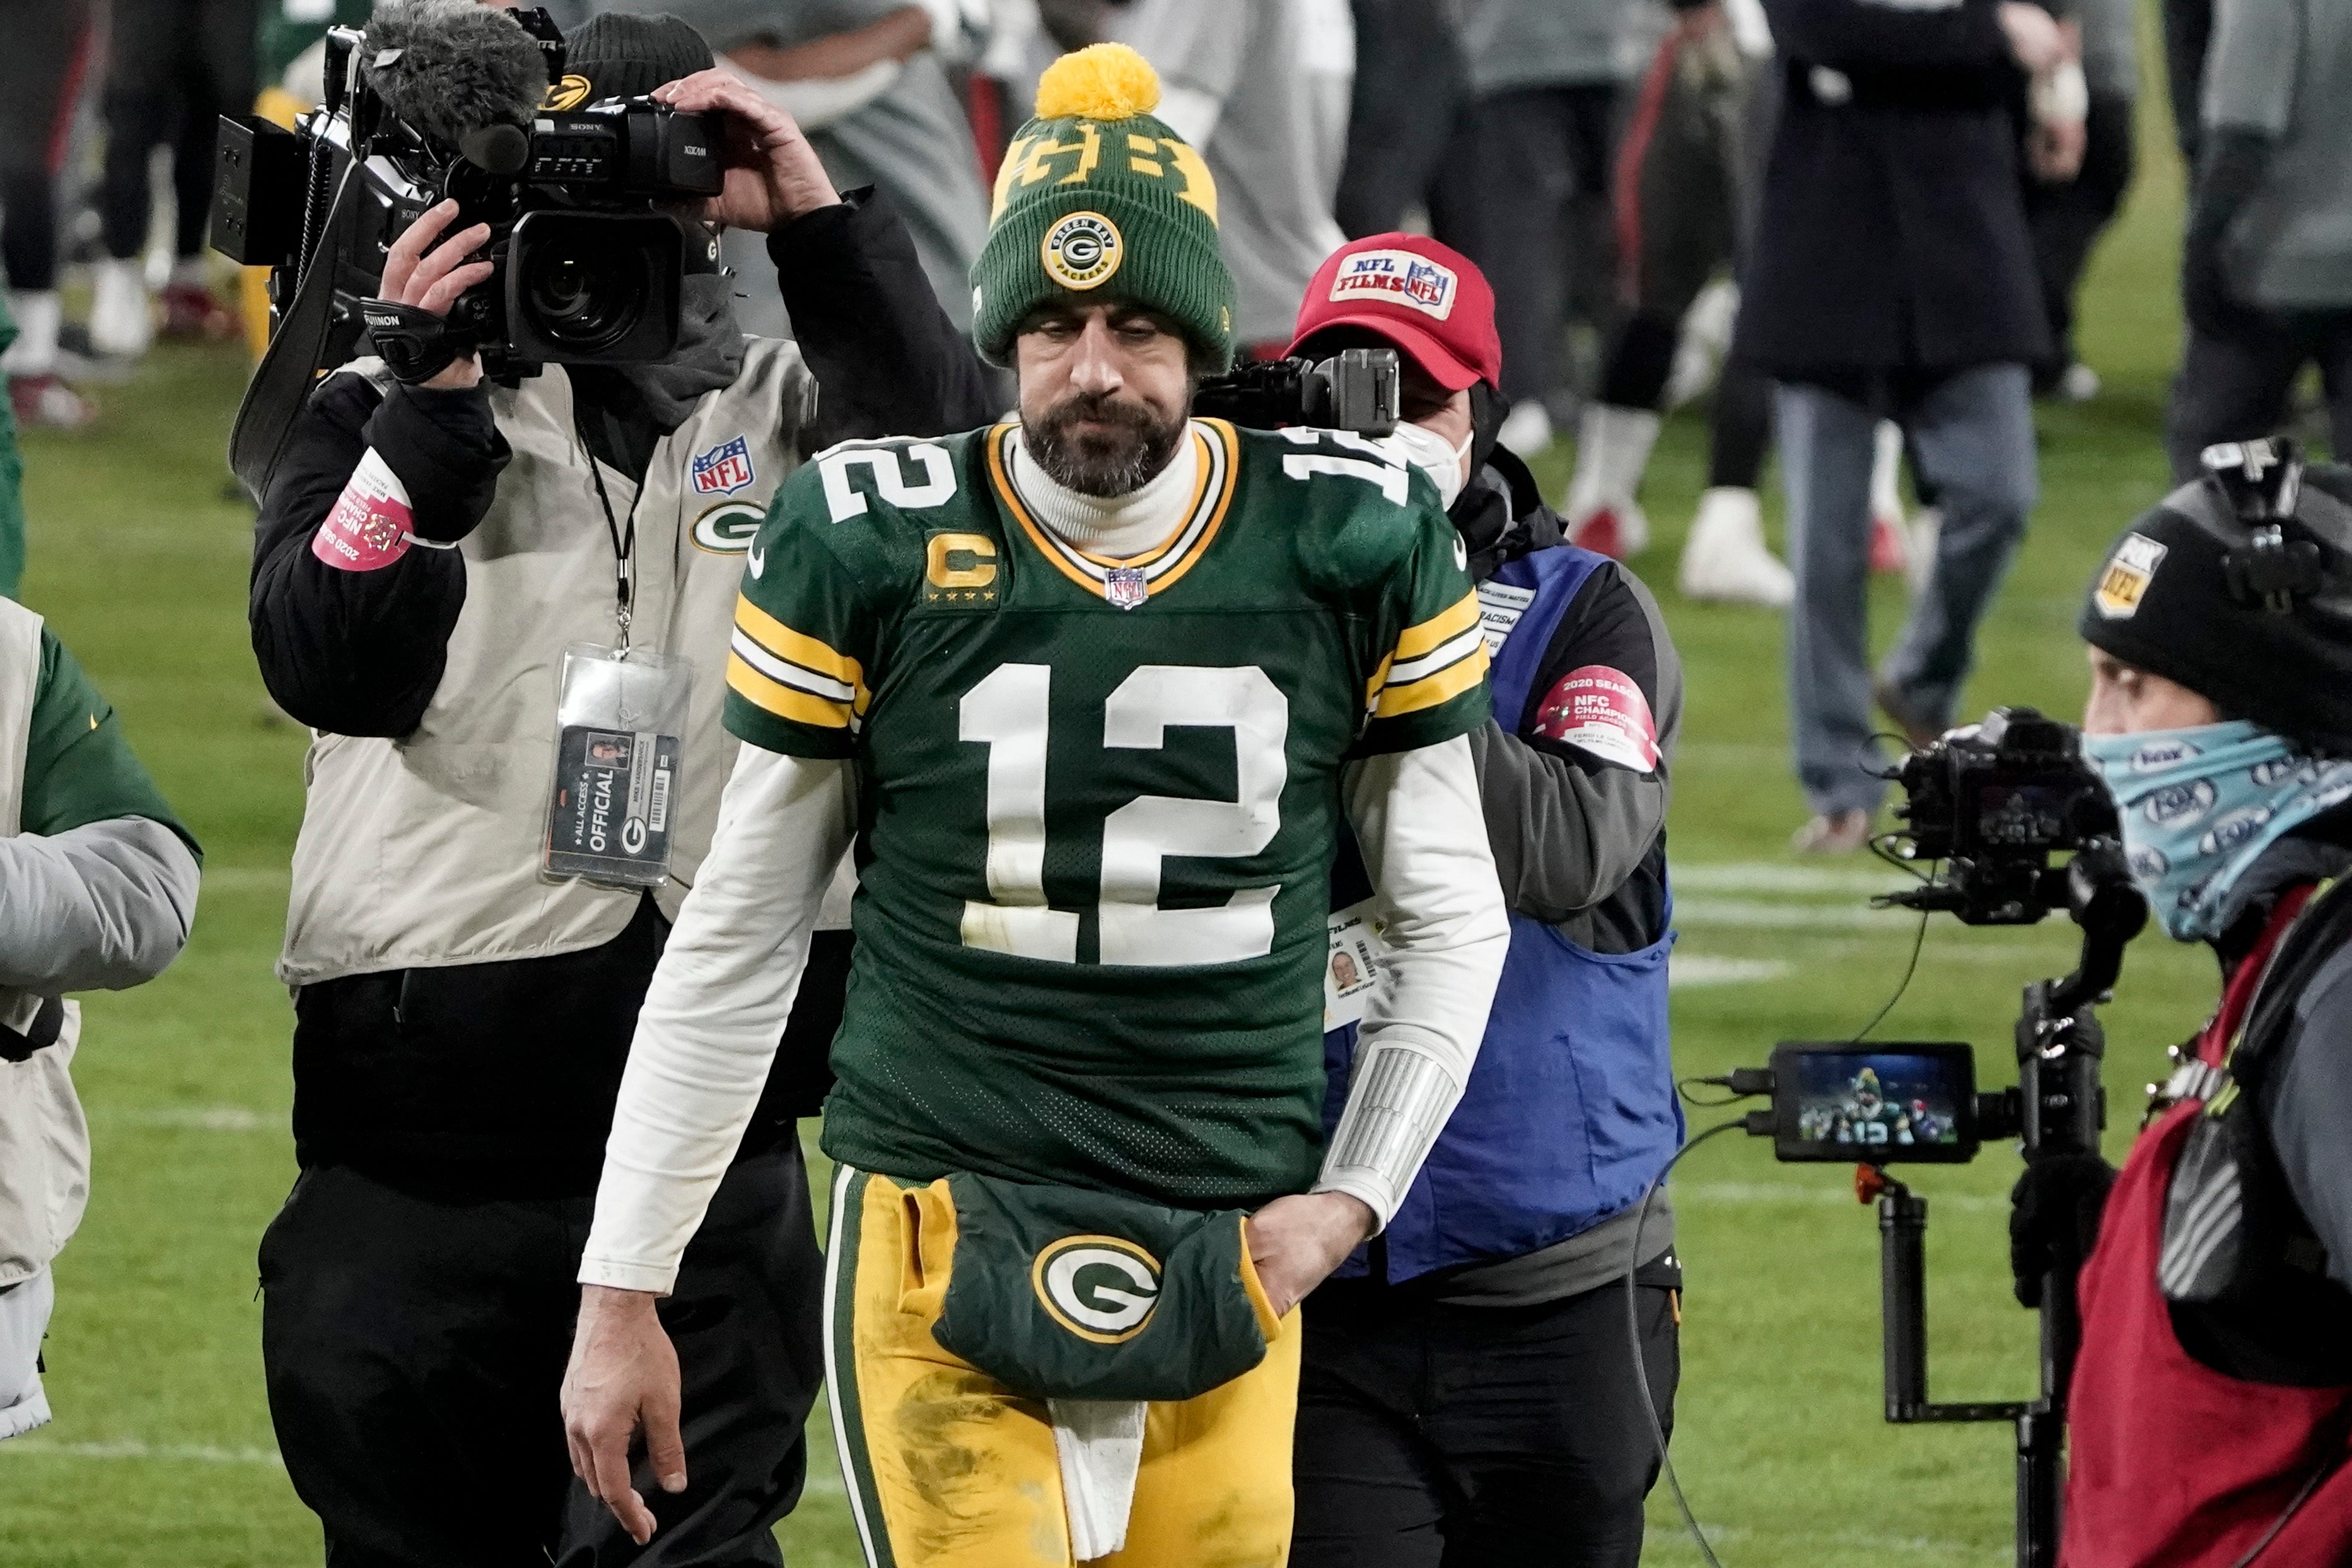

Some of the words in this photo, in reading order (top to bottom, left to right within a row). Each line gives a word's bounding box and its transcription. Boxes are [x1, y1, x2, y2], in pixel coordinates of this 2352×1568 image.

[1052, 219, 1090, 247] GREEN
[1093, 223, 1114, 245] BAY
[1064, 238, 1101, 260] G
[1056, 260, 1109, 281] PACKERS
[1353, 258, 1395, 273] NFL
[1337, 274, 1404, 293] FILMS
[1407, 277, 1440, 302] NFL
[364, 315, 400, 326] FUJINON
[697, 457, 748, 490] NFL
[337, 509, 363, 535] NFC
[335, 537, 361, 561] 2020
[927, 533, 997, 588] C
[1114, 581, 1141, 600] NFL
[1481, 610, 1516, 626] RACISM
[1563, 678, 1593, 691] 2020
[1574, 695, 1610, 707] NFC
[577, 781, 590, 818] ACCESS
[589, 769, 614, 852] OFFICIAL
[959, 662, 1289, 966] 12
[574, 817, 585, 837] ALL
[1046, 1248, 1159, 1332] G
